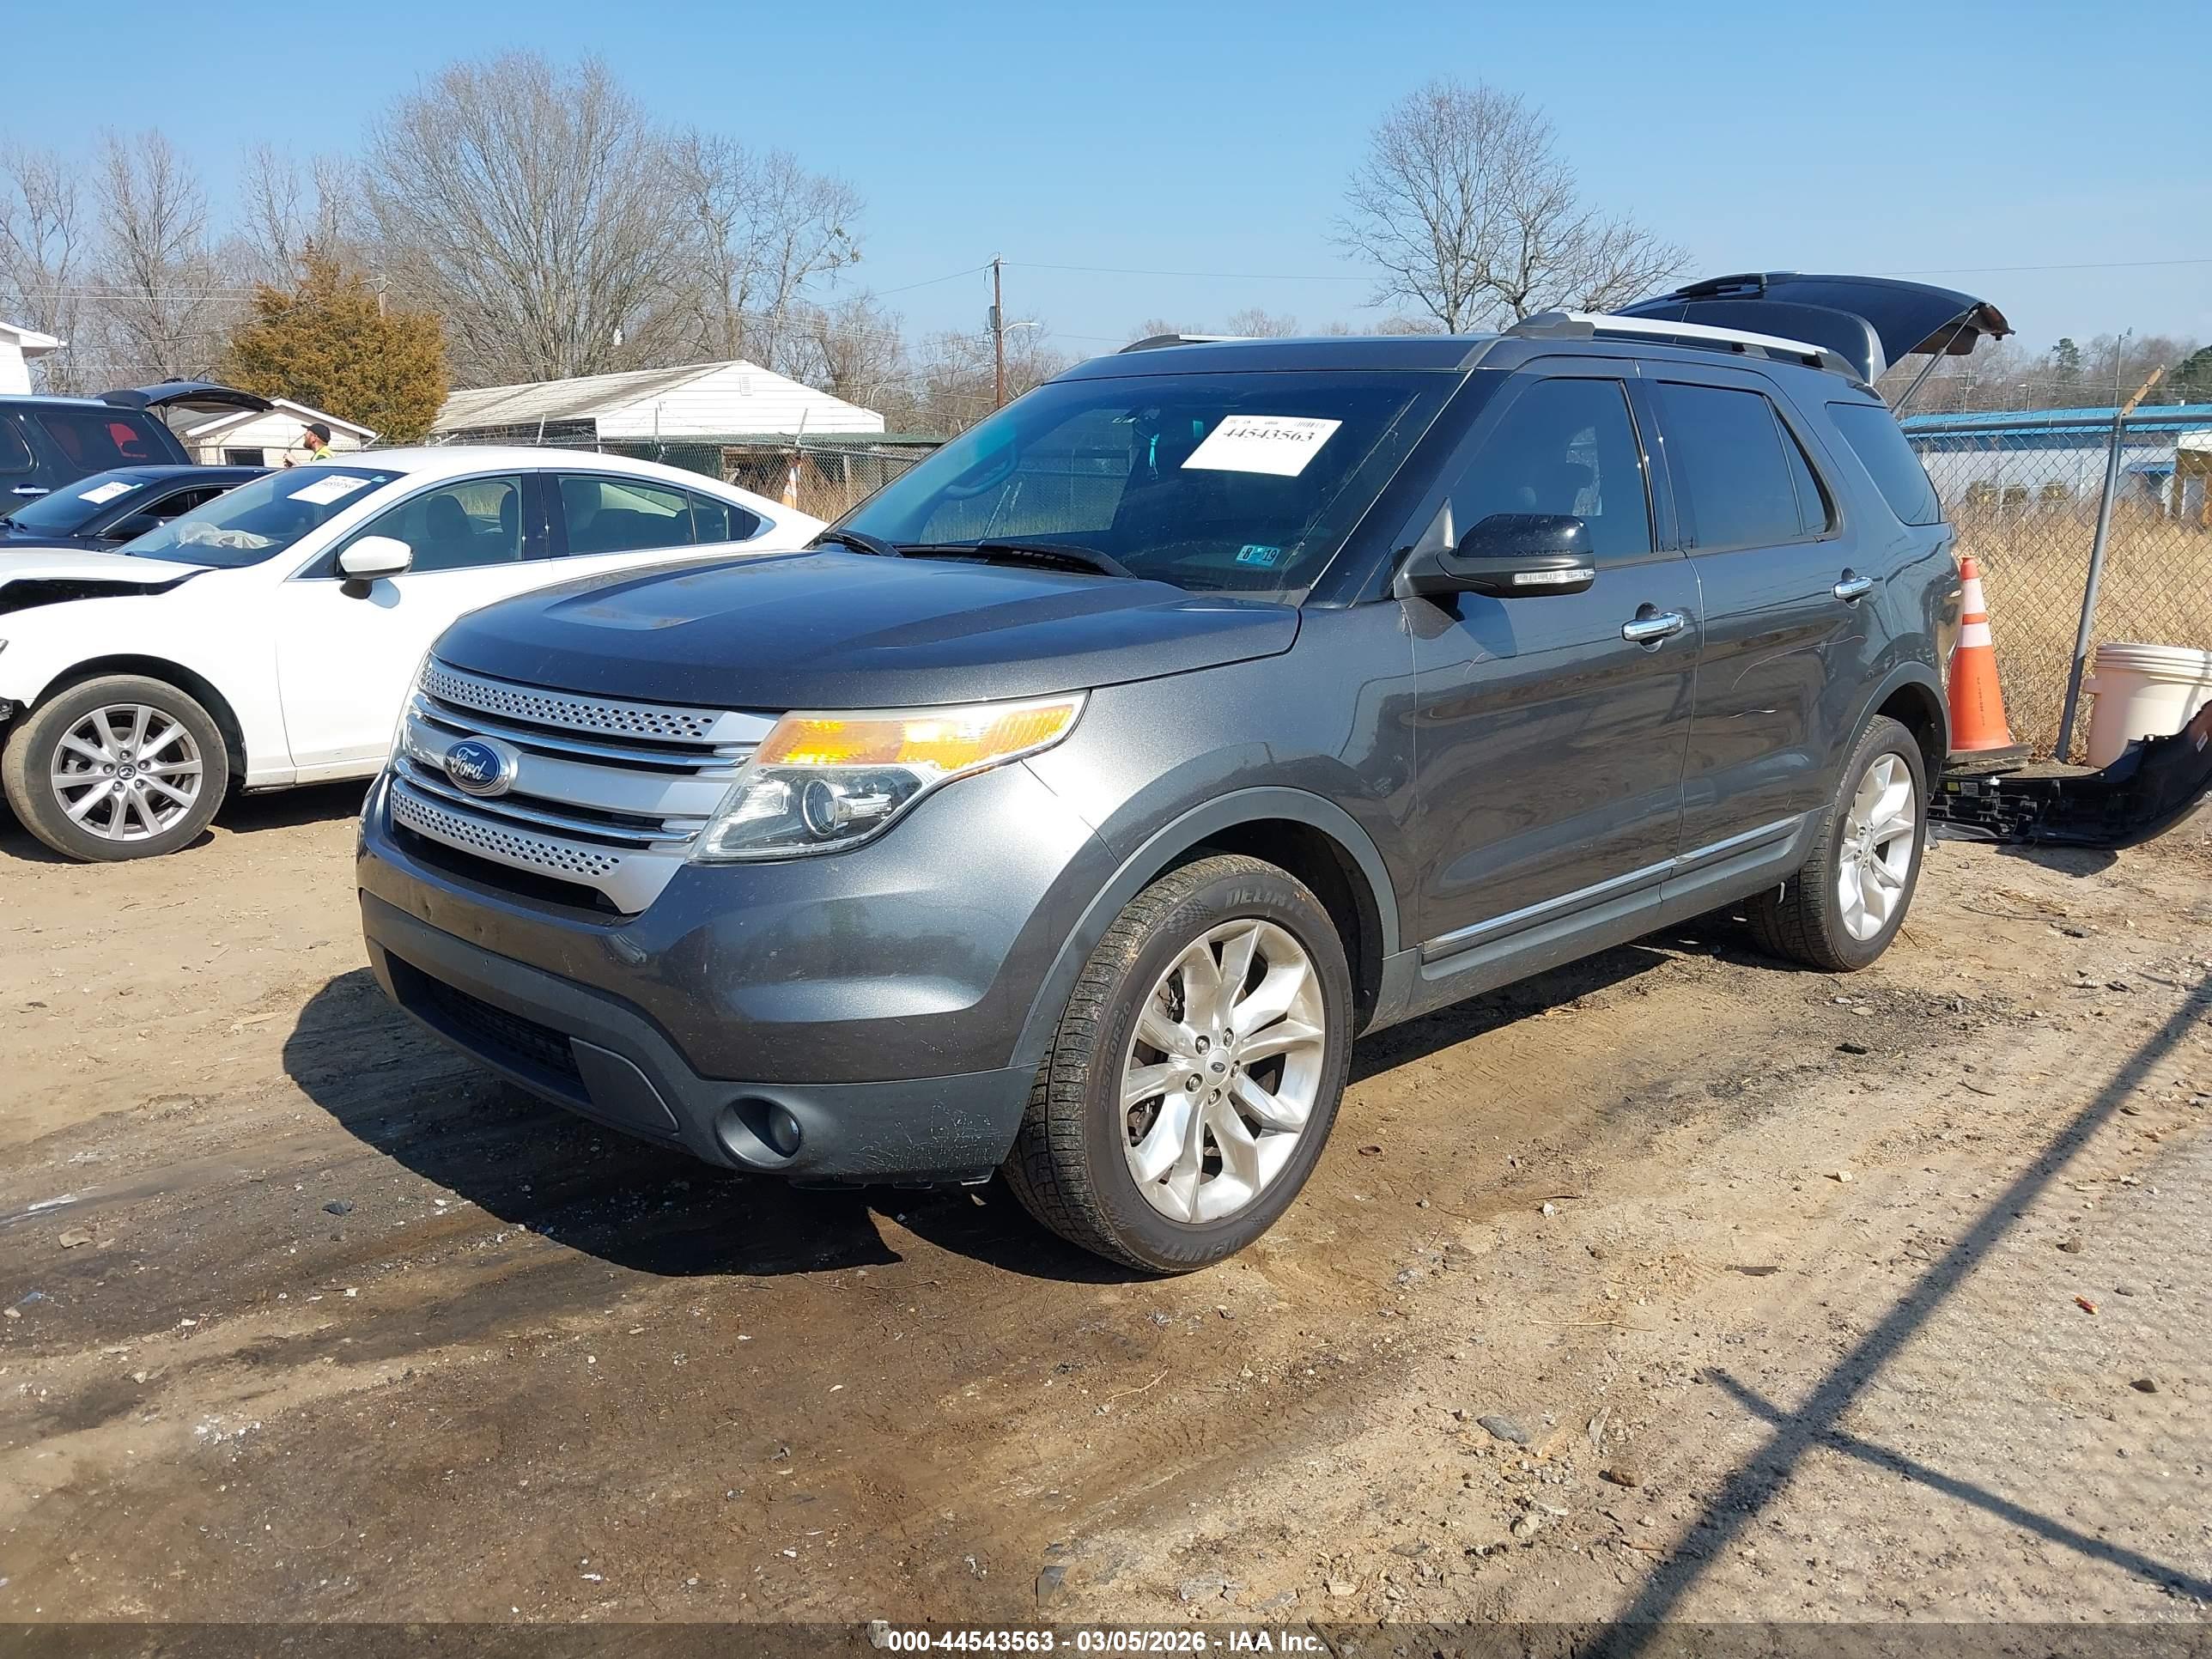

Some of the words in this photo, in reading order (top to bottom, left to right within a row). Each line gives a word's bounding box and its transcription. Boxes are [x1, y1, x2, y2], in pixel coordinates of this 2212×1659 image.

[1223, 428, 1315, 441] 44543563
[1243, 547, 1253, 560] 8
[1262, 549, 1278, 562] 19
[451, 746, 487, 781] Ford
[1100, 1000, 1132, 1113] 255/50R20
